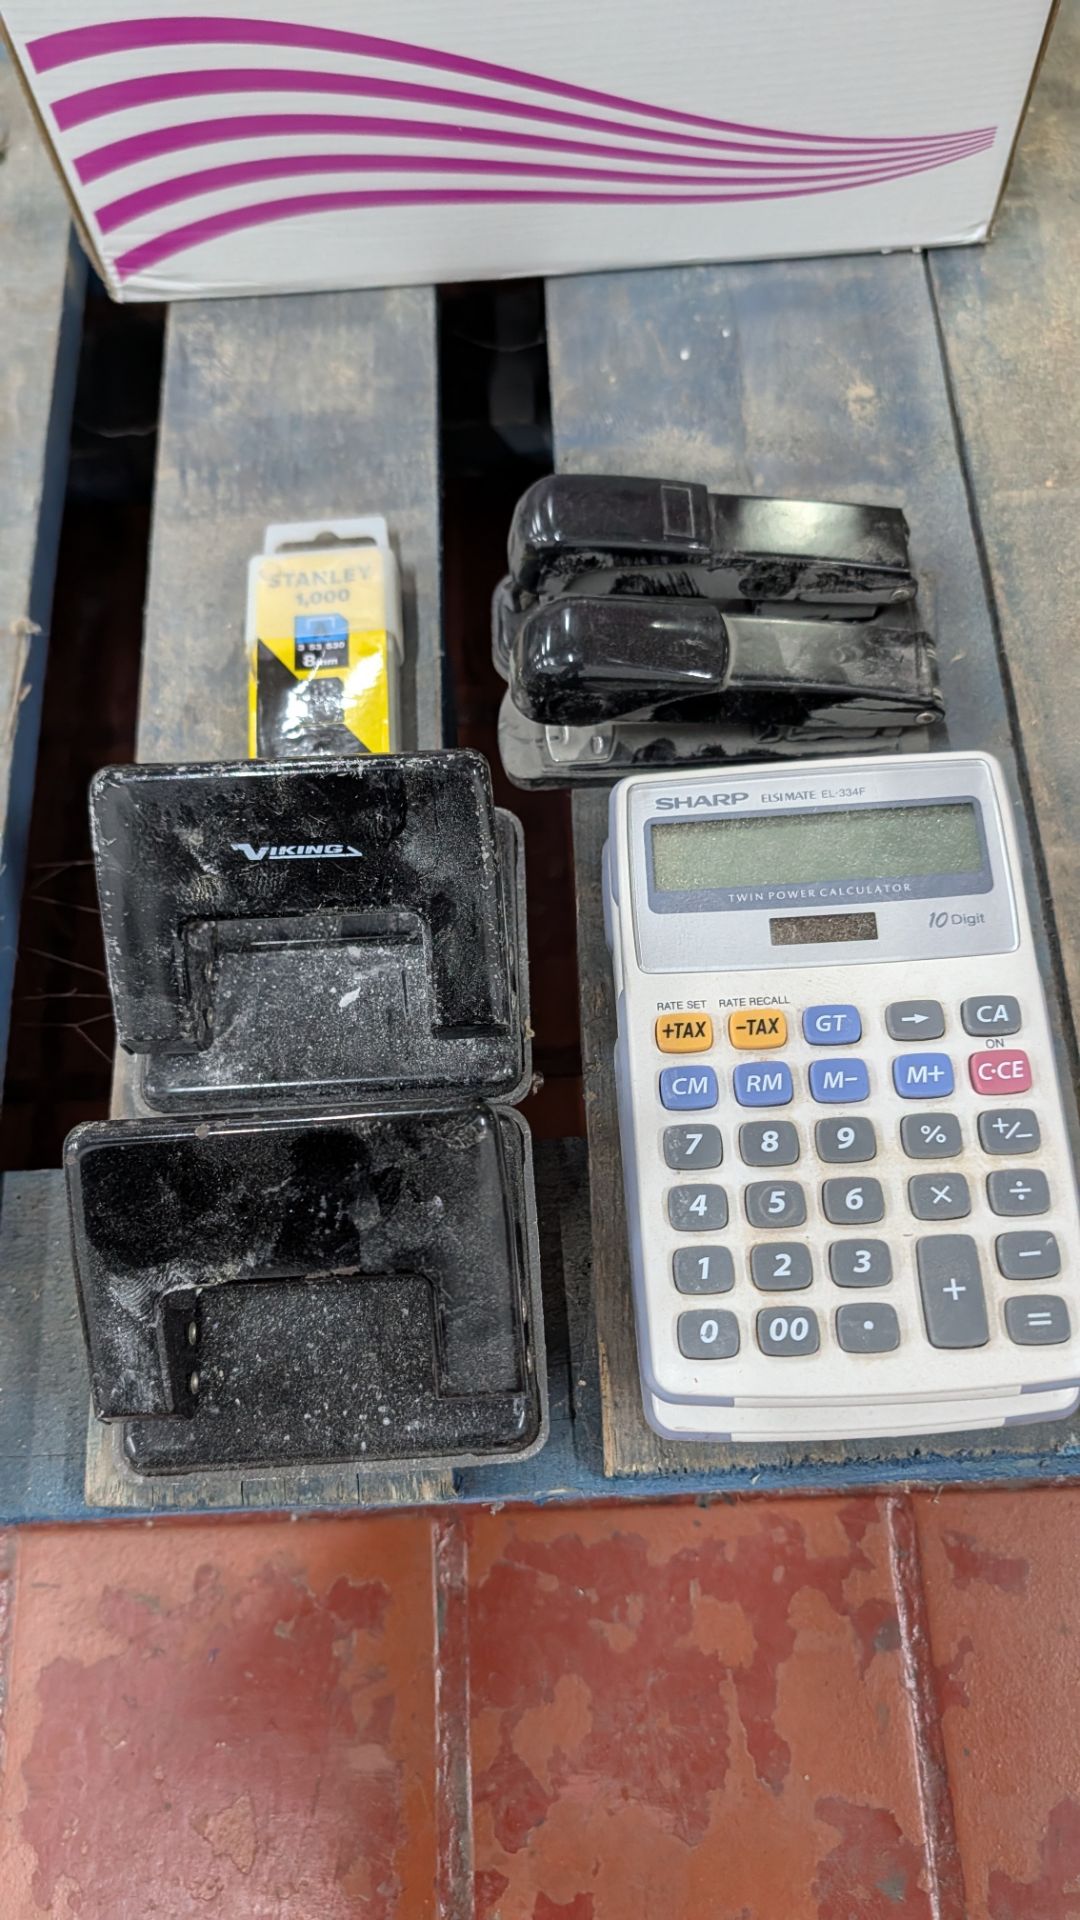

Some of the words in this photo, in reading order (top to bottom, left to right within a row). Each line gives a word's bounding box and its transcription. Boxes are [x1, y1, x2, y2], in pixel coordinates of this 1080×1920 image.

[268, 565, 371, 588] STANLEY
[655, 792, 749, 810] SHARP
[761, 790, 817, 803] ELSIMATE
[821, 787, 866, 798] EL-334F
[231, 843, 343, 860] VIKING
[729, 892, 764, 903] TWIN
[768, 889, 815, 900] POWER
[819, 882, 911, 897] CALCULATOR
[928, 912, 949, 928] 10
[951, 912, 985, 927] Digit
[657, 1001, 684, 1011] RATE
[686, 1000, 707, 1010] SET
[719, 998, 747, 1008] RATE
[749, 995, 791, 1006] RECALL
[816, 1014, 847, 1032] GT
[976, 1005, 1009, 1023] CA
[662, 1021, 706, 1039] +TAX
[985, 1038, 1004, 1049] ON
[746, 1073, 782, 1092] RM
[907, 1065, 945, 1084] M+
[672, 1076, 708, 1096] CM
[685, 1133, 703, 1155] 7
[761, 1131, 779, 1153] 8
[837, 1127, 855, 1149] 9
[921, 1124, 947, 1144] %
[689, 1194, 707, 1216] 4
[768, 1191, 786, 1213] 5
[845, 1188, 863, 1210] 6
[698, 1256, 710, 1280] 1
[773, 1254, 792, 1276] 2
[853, 1250, 871, 1273] 3
[700, 1320, 719, 1344] 0
[769, 1317, 808, 1341] 00
